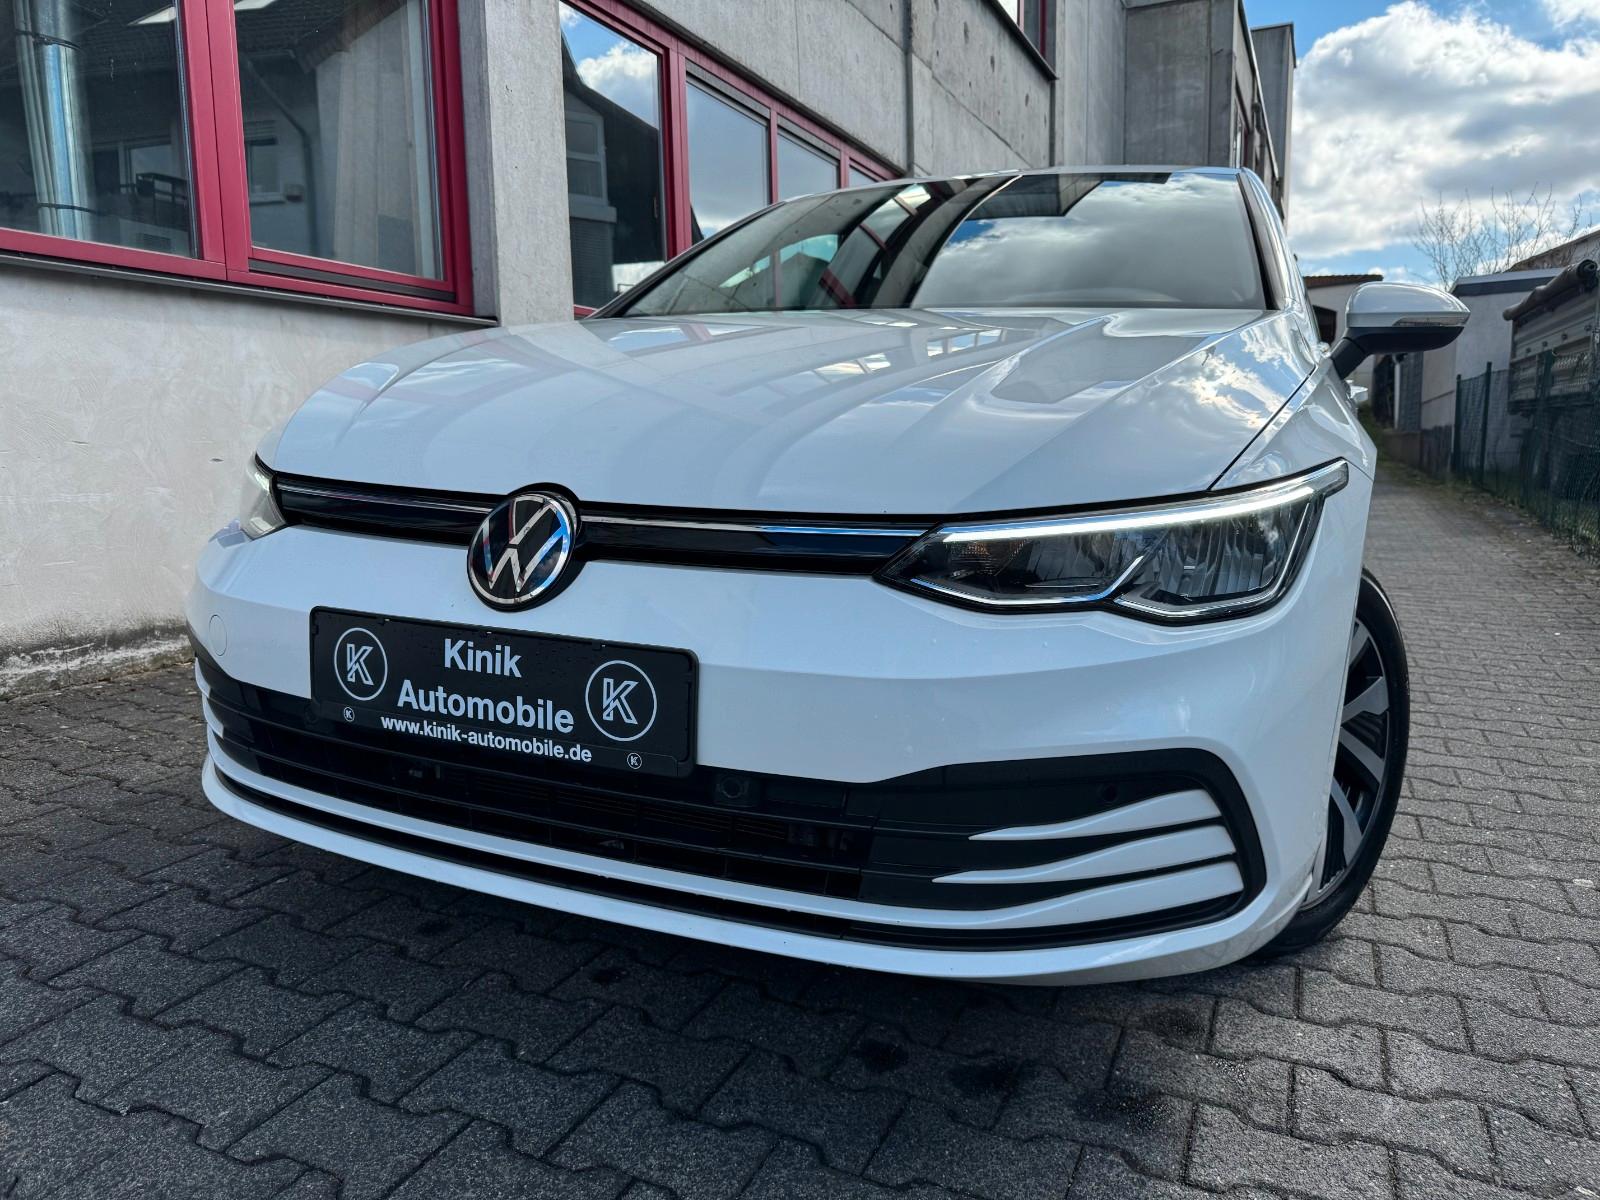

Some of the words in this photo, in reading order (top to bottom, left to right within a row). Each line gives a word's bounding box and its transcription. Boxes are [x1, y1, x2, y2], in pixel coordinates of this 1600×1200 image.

[346, 643, 374, 686] K
[445, 638, 522, 678] Kinik
[397, 680, 574, 734] Automobile
[602, 677, 639, 725] K
[381, 716, 592, 763] www.kinik-automobile.de
